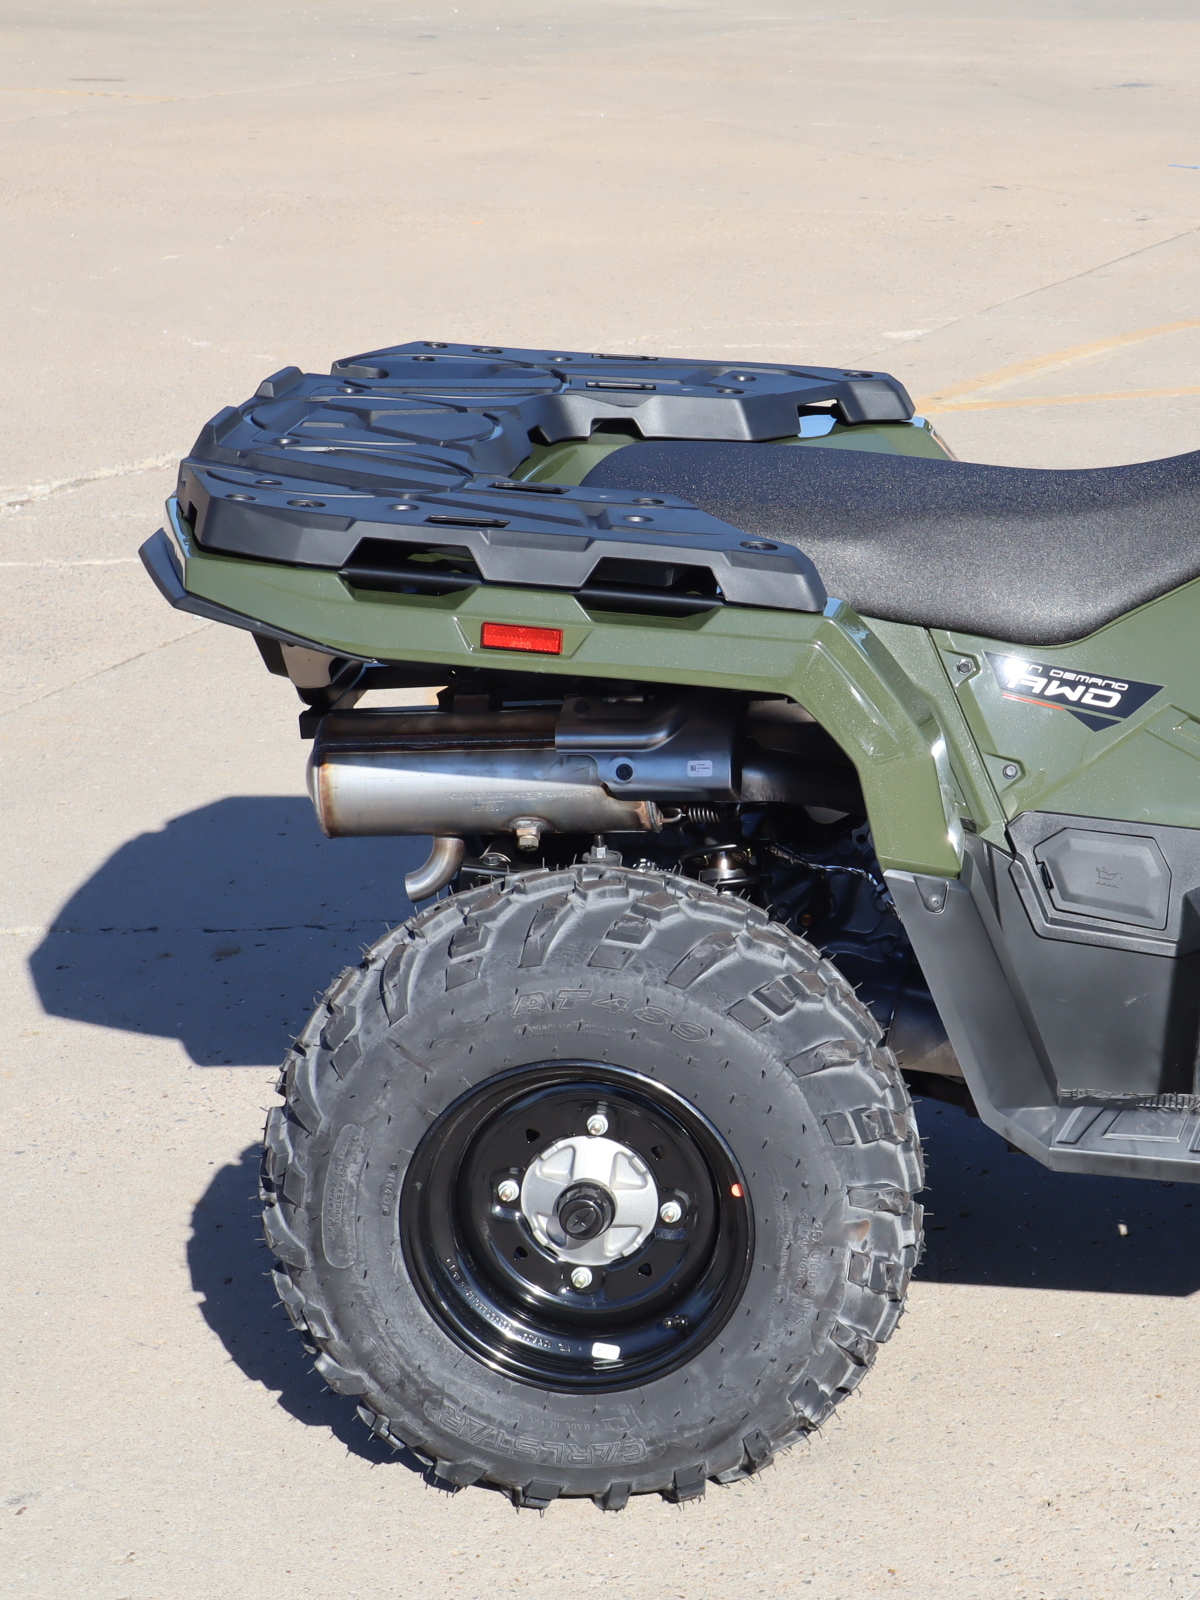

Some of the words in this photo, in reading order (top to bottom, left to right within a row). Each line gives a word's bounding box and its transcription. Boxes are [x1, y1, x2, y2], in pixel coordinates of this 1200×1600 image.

[1006, 676, 1122, 708] AWD
[1049, 668, 1129, 691] DEMAND
[438, 1406, 647, 1465] CARLSTAR
